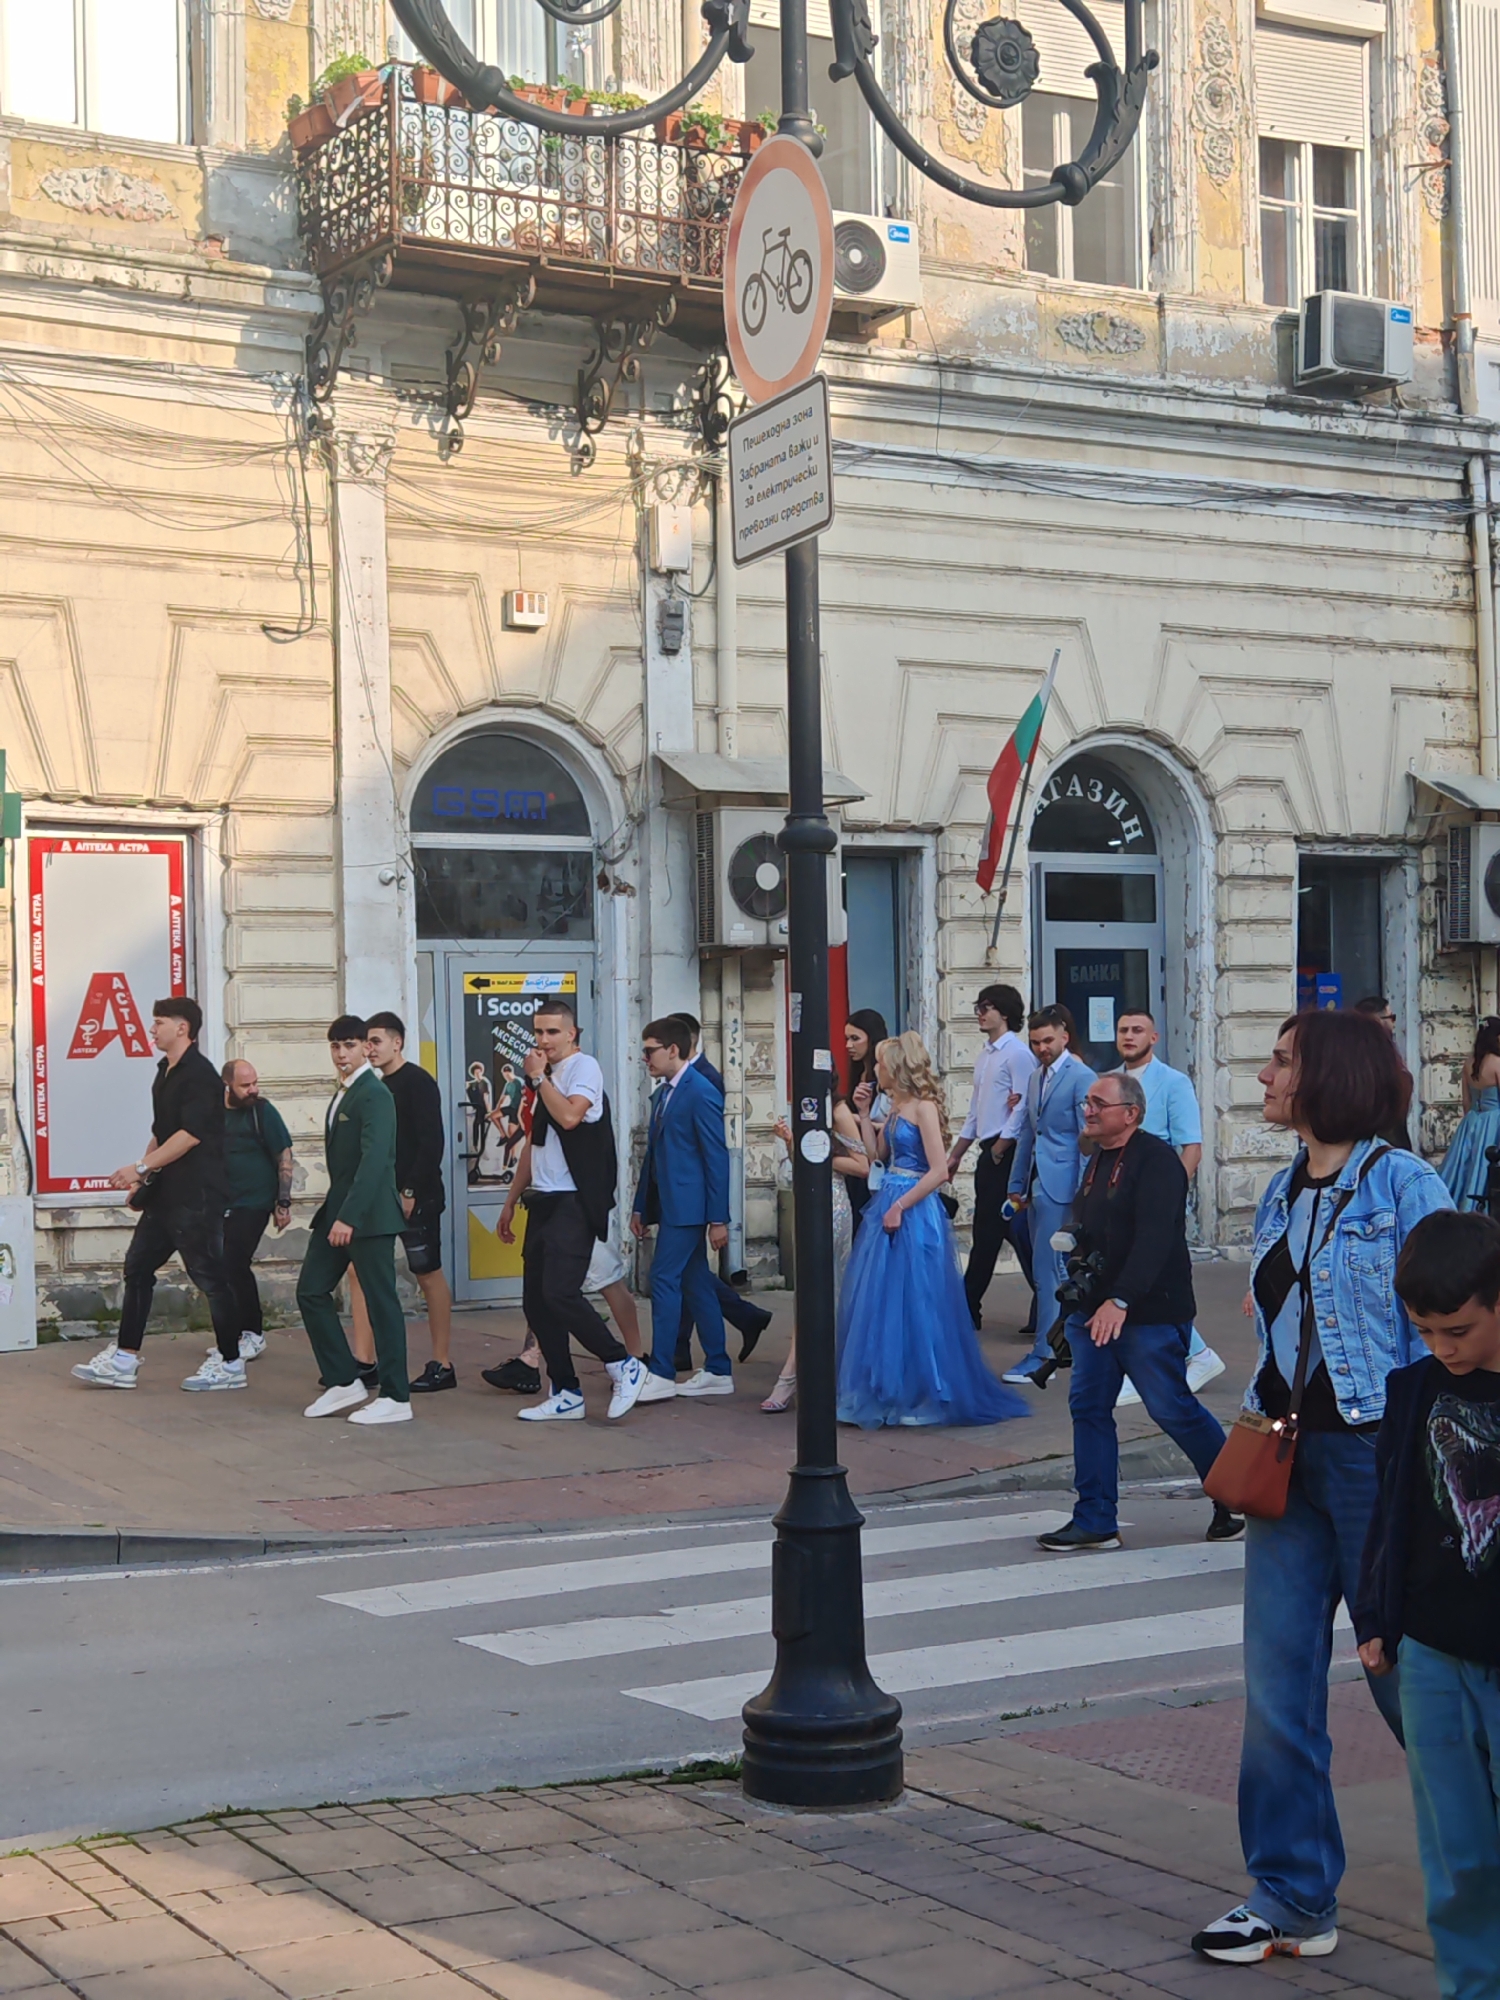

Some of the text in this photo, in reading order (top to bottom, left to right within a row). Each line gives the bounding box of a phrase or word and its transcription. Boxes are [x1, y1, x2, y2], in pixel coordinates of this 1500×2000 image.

[742, 406, 813, 453] Пешеходна зона
[739, 434, 819, 483] Забраната важи и
[744, 464, 818, 509] за електрически
[738, 491, 824, 541] превозни средства
[433, 786, 546, 820] GSM
[75, 842, 114, 852] АПТЕКА
[118, 843, 150, 852] АСТРА
[32, 893, 42, 927] АСТРА
[172, 910, 181, 949] АПТЕКА
[33, 930, 43, 972] АПТЕКА
[172, 953, 182, 985] АСТРА
[1070, 964, 1120, 984] БАНКЯ
[112, 976, 144, 1053] АСТРА
[36, 1044, 45, 1079] АСТРА
[37, 1082, 46, 1123] АПТЕКА
